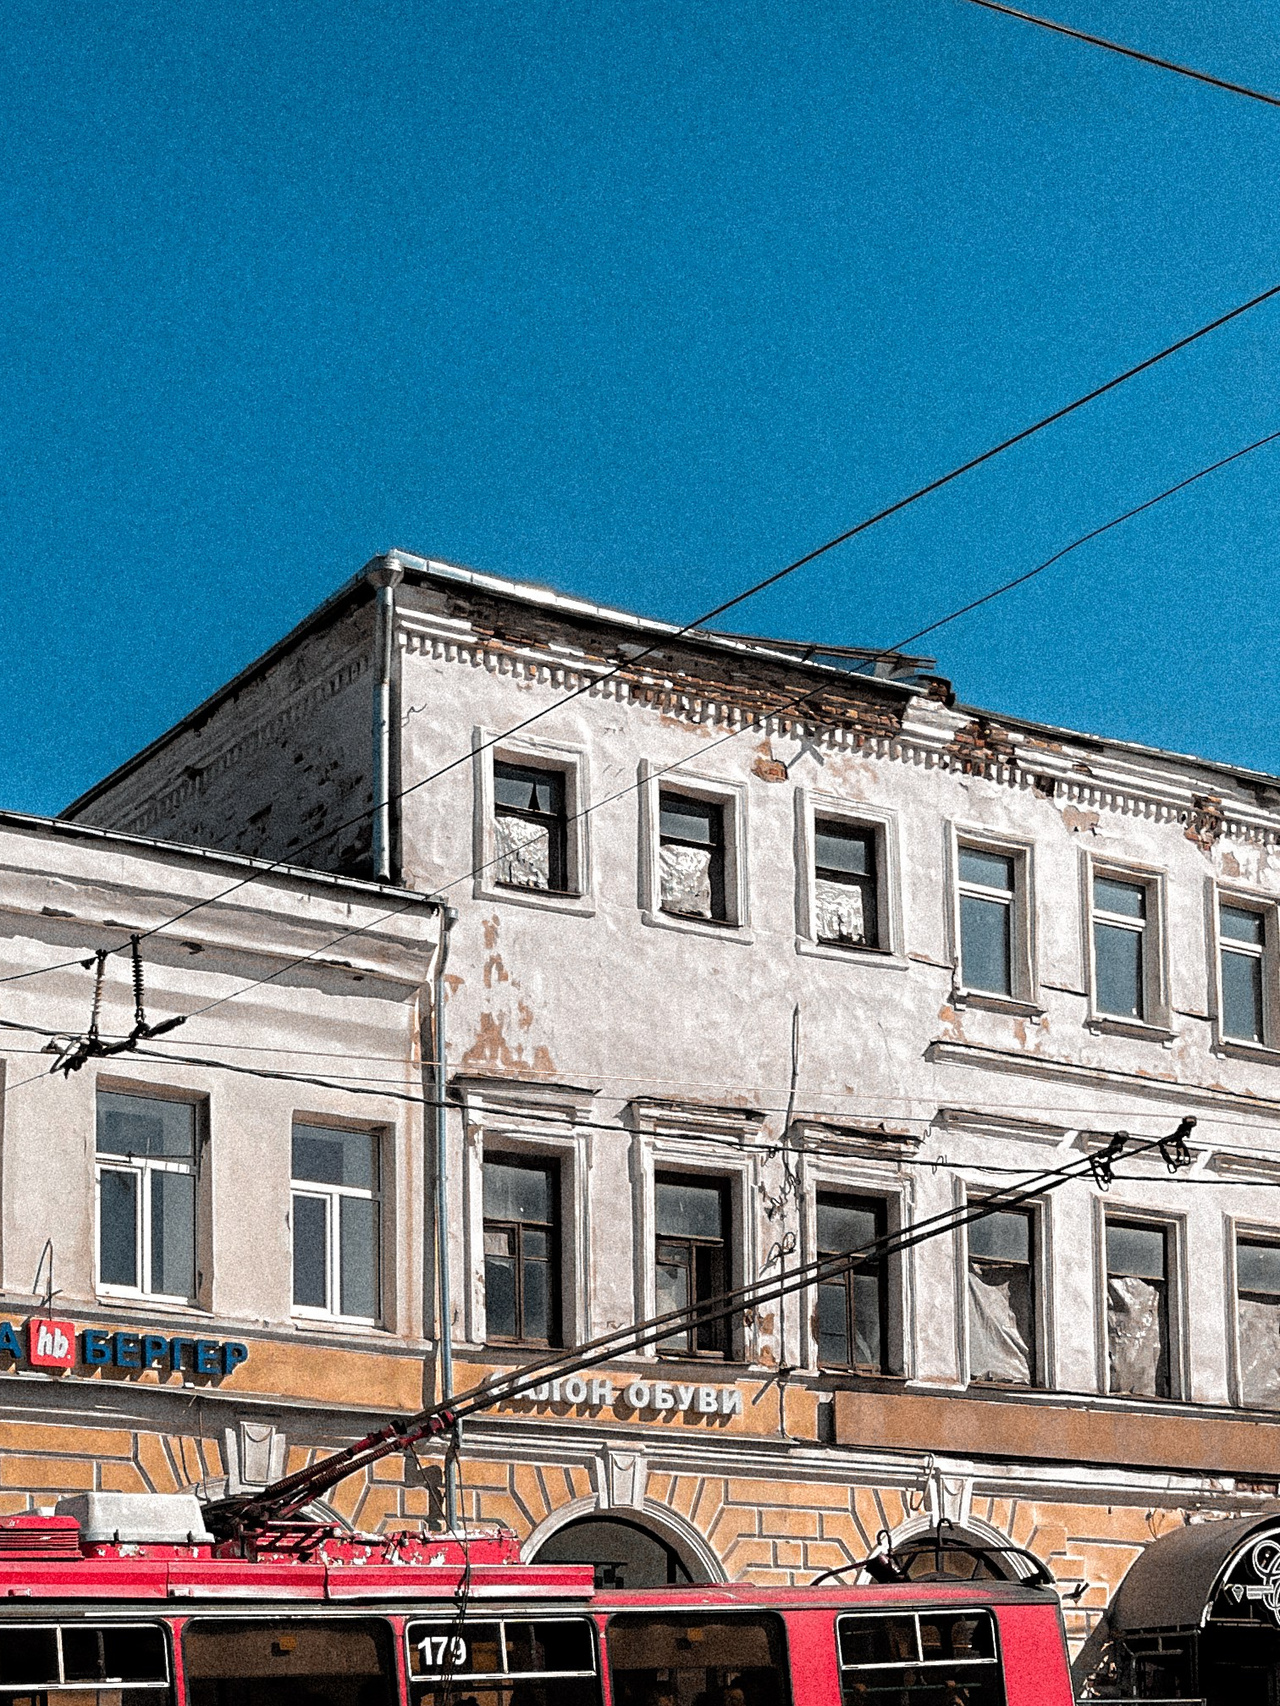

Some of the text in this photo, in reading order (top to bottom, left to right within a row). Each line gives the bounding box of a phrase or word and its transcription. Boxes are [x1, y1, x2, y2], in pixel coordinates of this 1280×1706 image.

[82, 1329, 249, 1375] БЕРГЕР
[626, 1382, 743, 1415] ОБУВИ
[417, 1636, 467, 1666] 179
